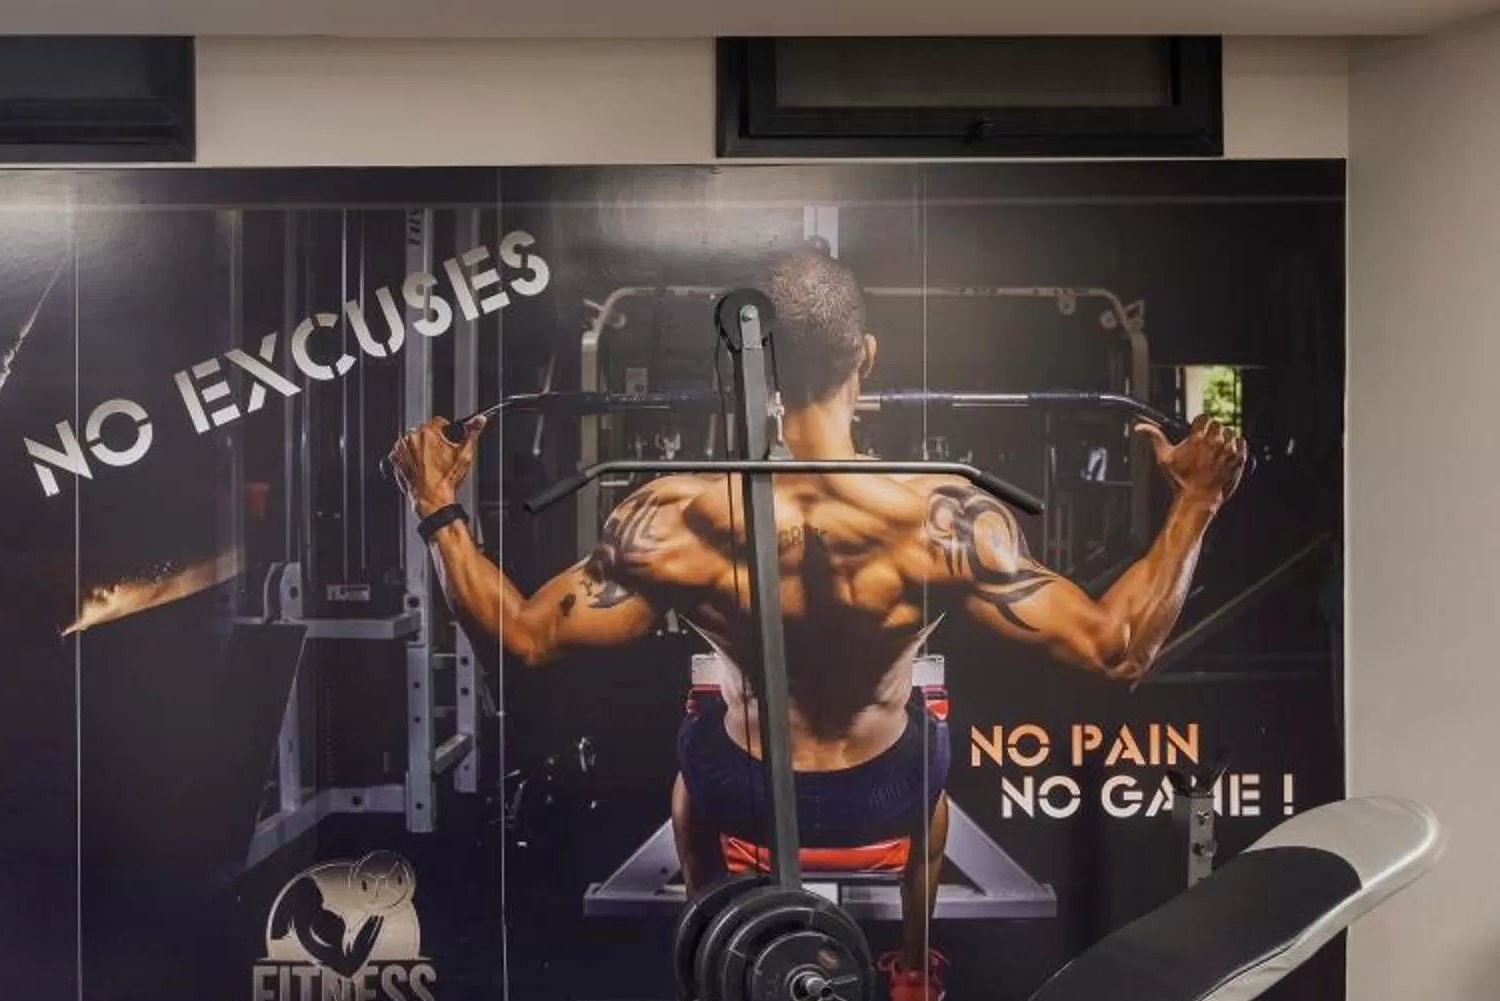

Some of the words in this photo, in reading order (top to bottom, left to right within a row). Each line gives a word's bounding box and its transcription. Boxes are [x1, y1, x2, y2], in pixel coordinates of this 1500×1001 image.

[23, 398, 154, 496] NO
[174, 229, 551, 434] EXCUSES
[970, 724, 1050, 767] NO
[1071, 723, 1200, 766] PAIN
[1001, 774, 1081, 819] NO
